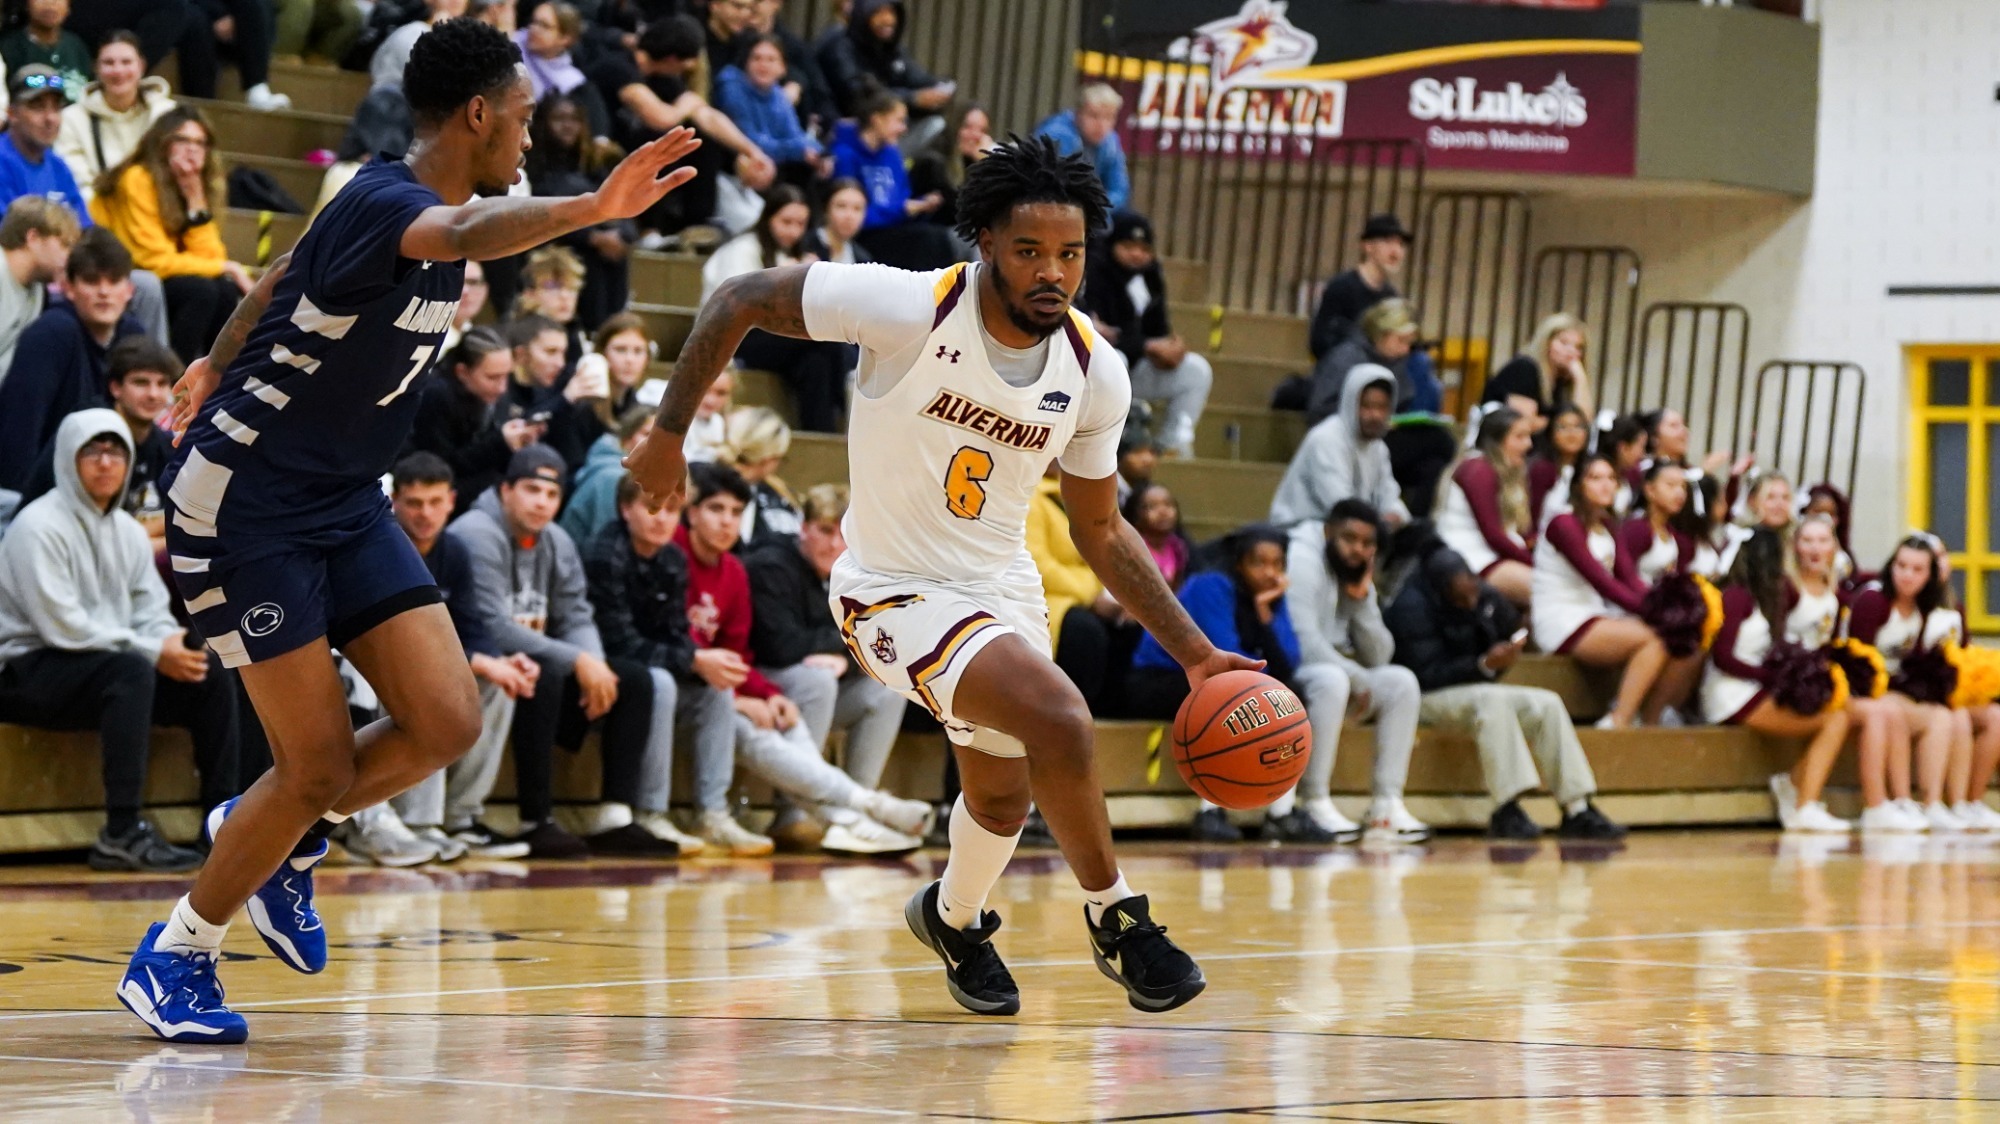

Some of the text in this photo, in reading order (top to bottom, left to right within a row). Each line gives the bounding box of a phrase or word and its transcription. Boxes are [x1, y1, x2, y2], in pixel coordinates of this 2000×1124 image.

[1427, 125, 1570, 154] Sports Medicine
[925, 391, 1052, 450] ALVERNIA
[1039, 399, 1068, 412] MAC
[944, 445, 994, 520] 6
[1222, 689, 1305, 737] THE ROC
